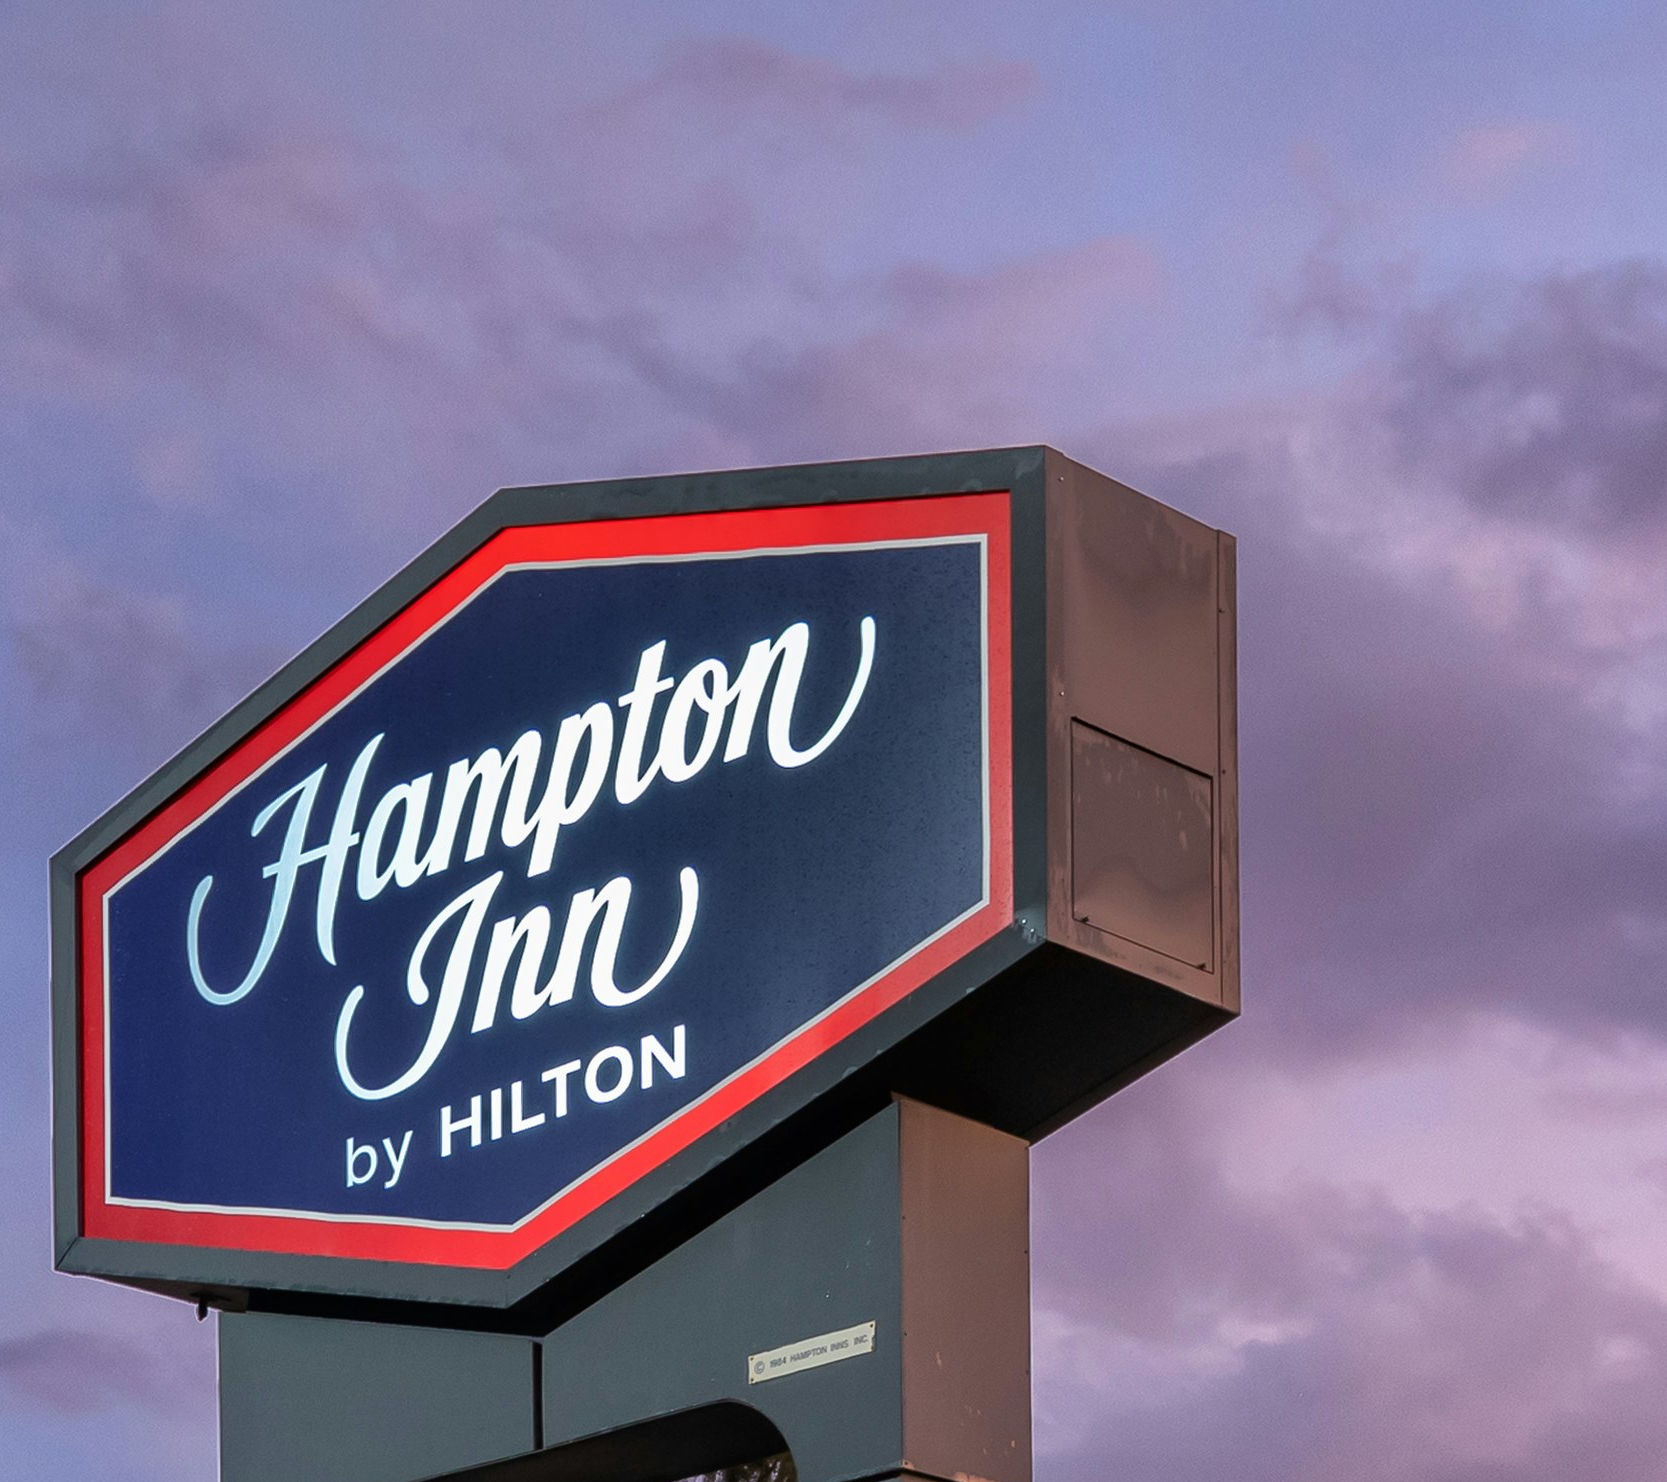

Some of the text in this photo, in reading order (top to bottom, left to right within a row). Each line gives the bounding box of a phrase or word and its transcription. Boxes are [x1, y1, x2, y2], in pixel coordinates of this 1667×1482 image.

[186, 615, 876, 1006] Hampton
[335, 866, 700, 1100] Inn
[346, 1023, 686, 1189] by HILTON
[790, 1346, 828, 1362] HAMPTON
[830, 1339, 849, 1352] INNS
